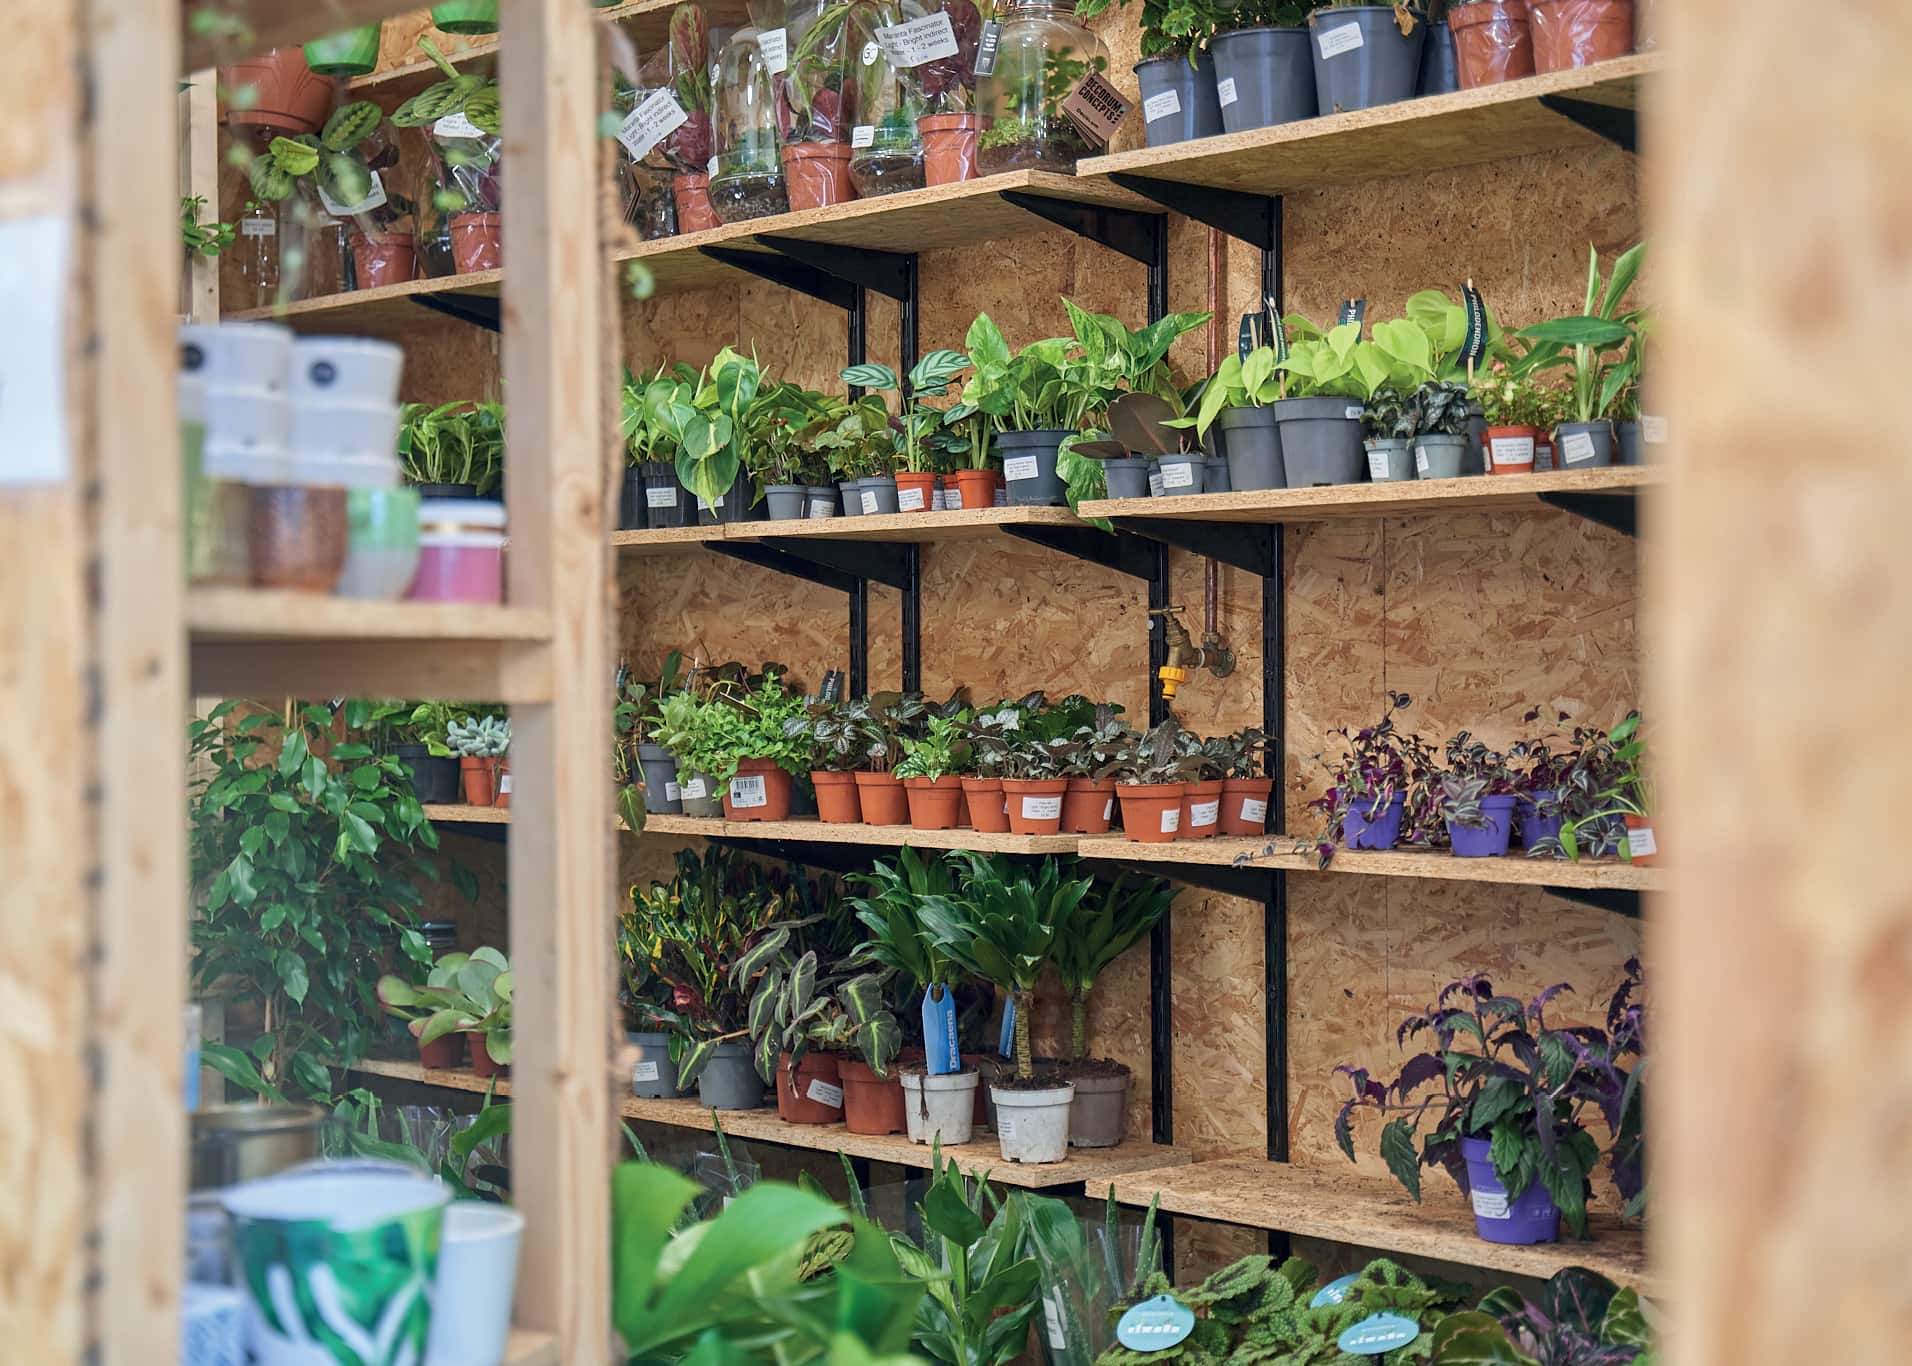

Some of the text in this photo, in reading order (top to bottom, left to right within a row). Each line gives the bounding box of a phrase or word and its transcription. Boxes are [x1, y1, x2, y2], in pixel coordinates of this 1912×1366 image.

[902, 34, 923, 47] Bright
[924, 26, 948, 39] indirect
[927, 37, 949, 47] weeks
[1078, 86, 1115, 121] CONCEPTS
[1086, 77, 1122, 113] DECORUM
[1470, 293, 1482, 357] PHILODENDRON
[946, 1009, 957, 1070] Dracaena
